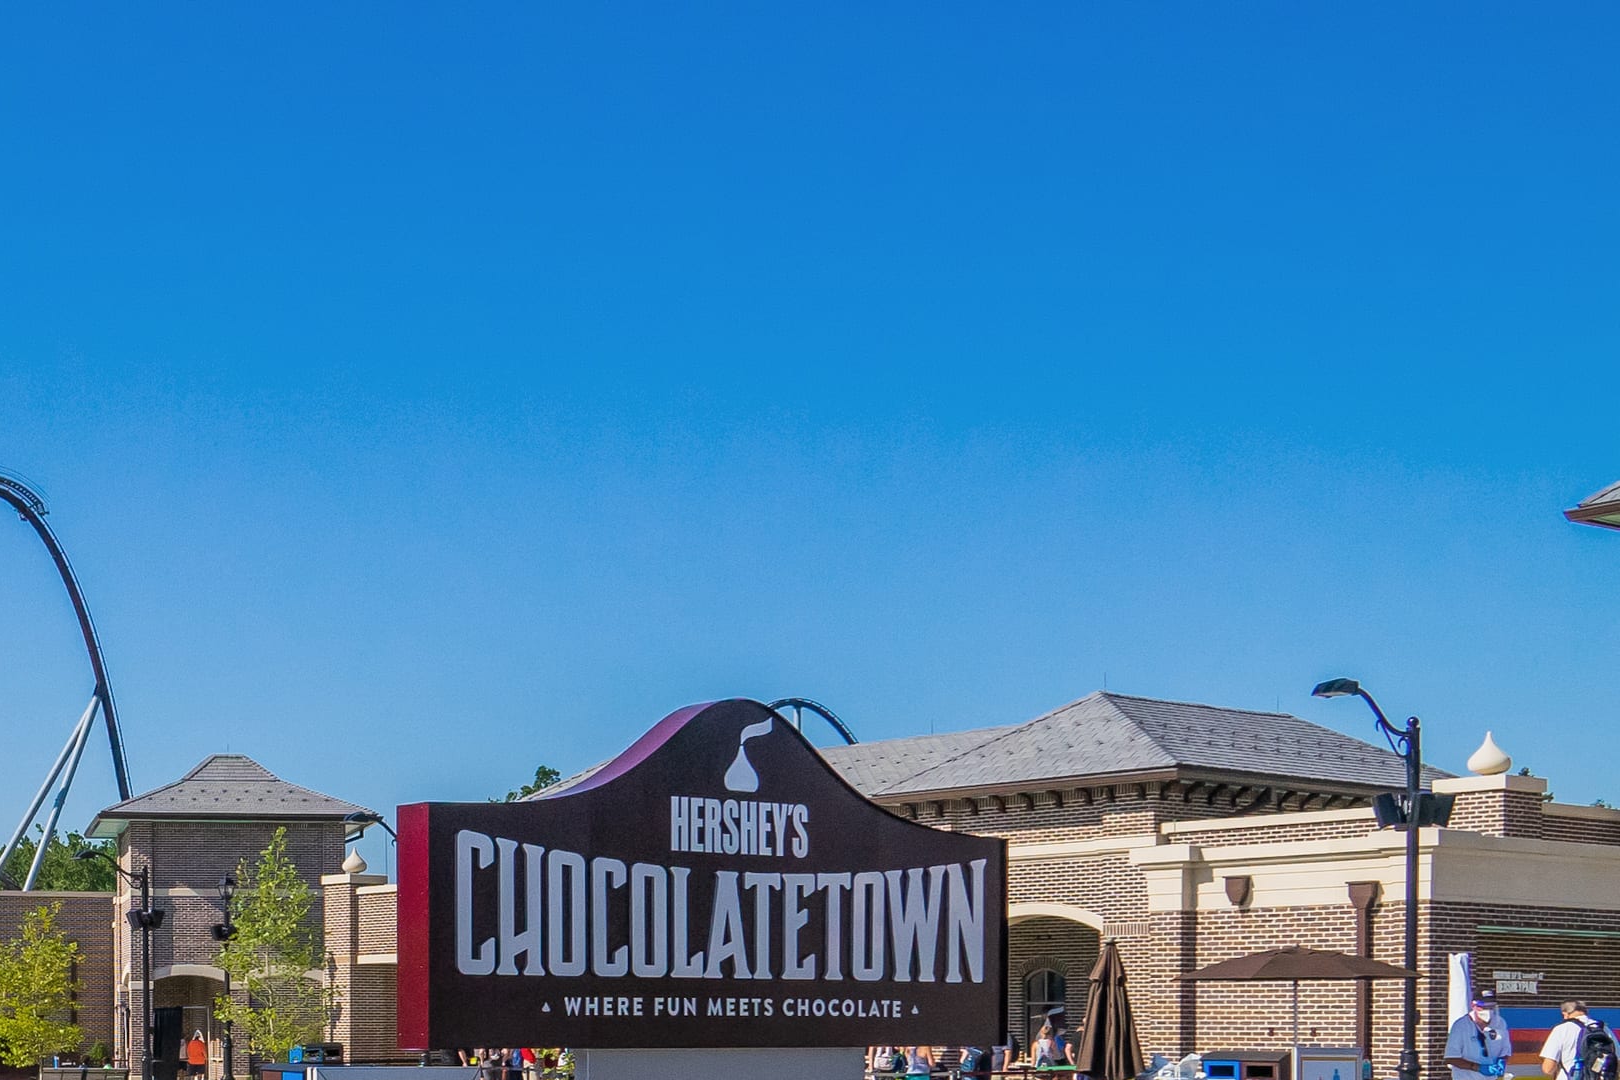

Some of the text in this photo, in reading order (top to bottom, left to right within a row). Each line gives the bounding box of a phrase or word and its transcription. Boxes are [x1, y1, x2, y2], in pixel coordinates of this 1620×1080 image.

[670, 795, 809, 859] HERSHEY'S
[454, 829, 987, 983] CHOCOLATETOWN
[564, 996, 903, 1018] WHERE FUN MEETS CHOCOLATE
